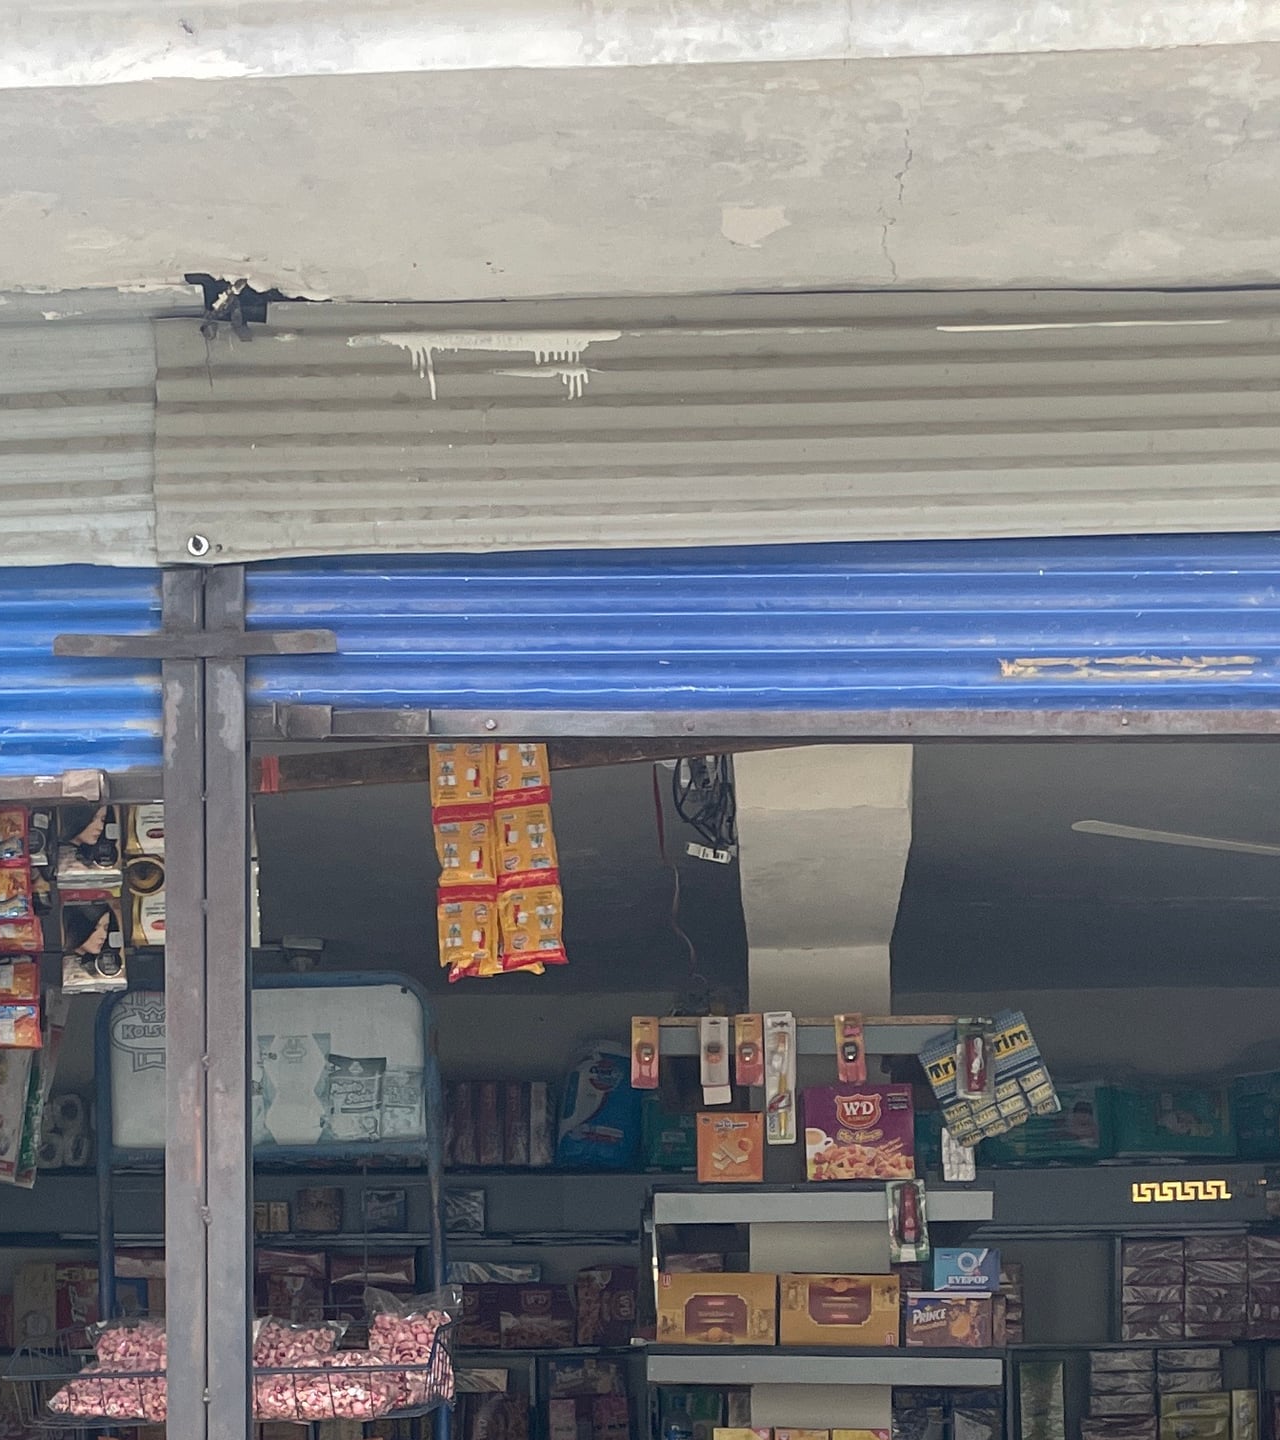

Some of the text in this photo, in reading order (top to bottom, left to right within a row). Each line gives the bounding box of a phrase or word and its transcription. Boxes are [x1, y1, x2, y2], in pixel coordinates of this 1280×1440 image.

[122, 1025, 165, 1039] KOLSO
[993, 1030, 1029, 1052] rim
[948, 1275, 989, 1284] EYEPOP
[912, 1308, 947, 1325] PRINCE
